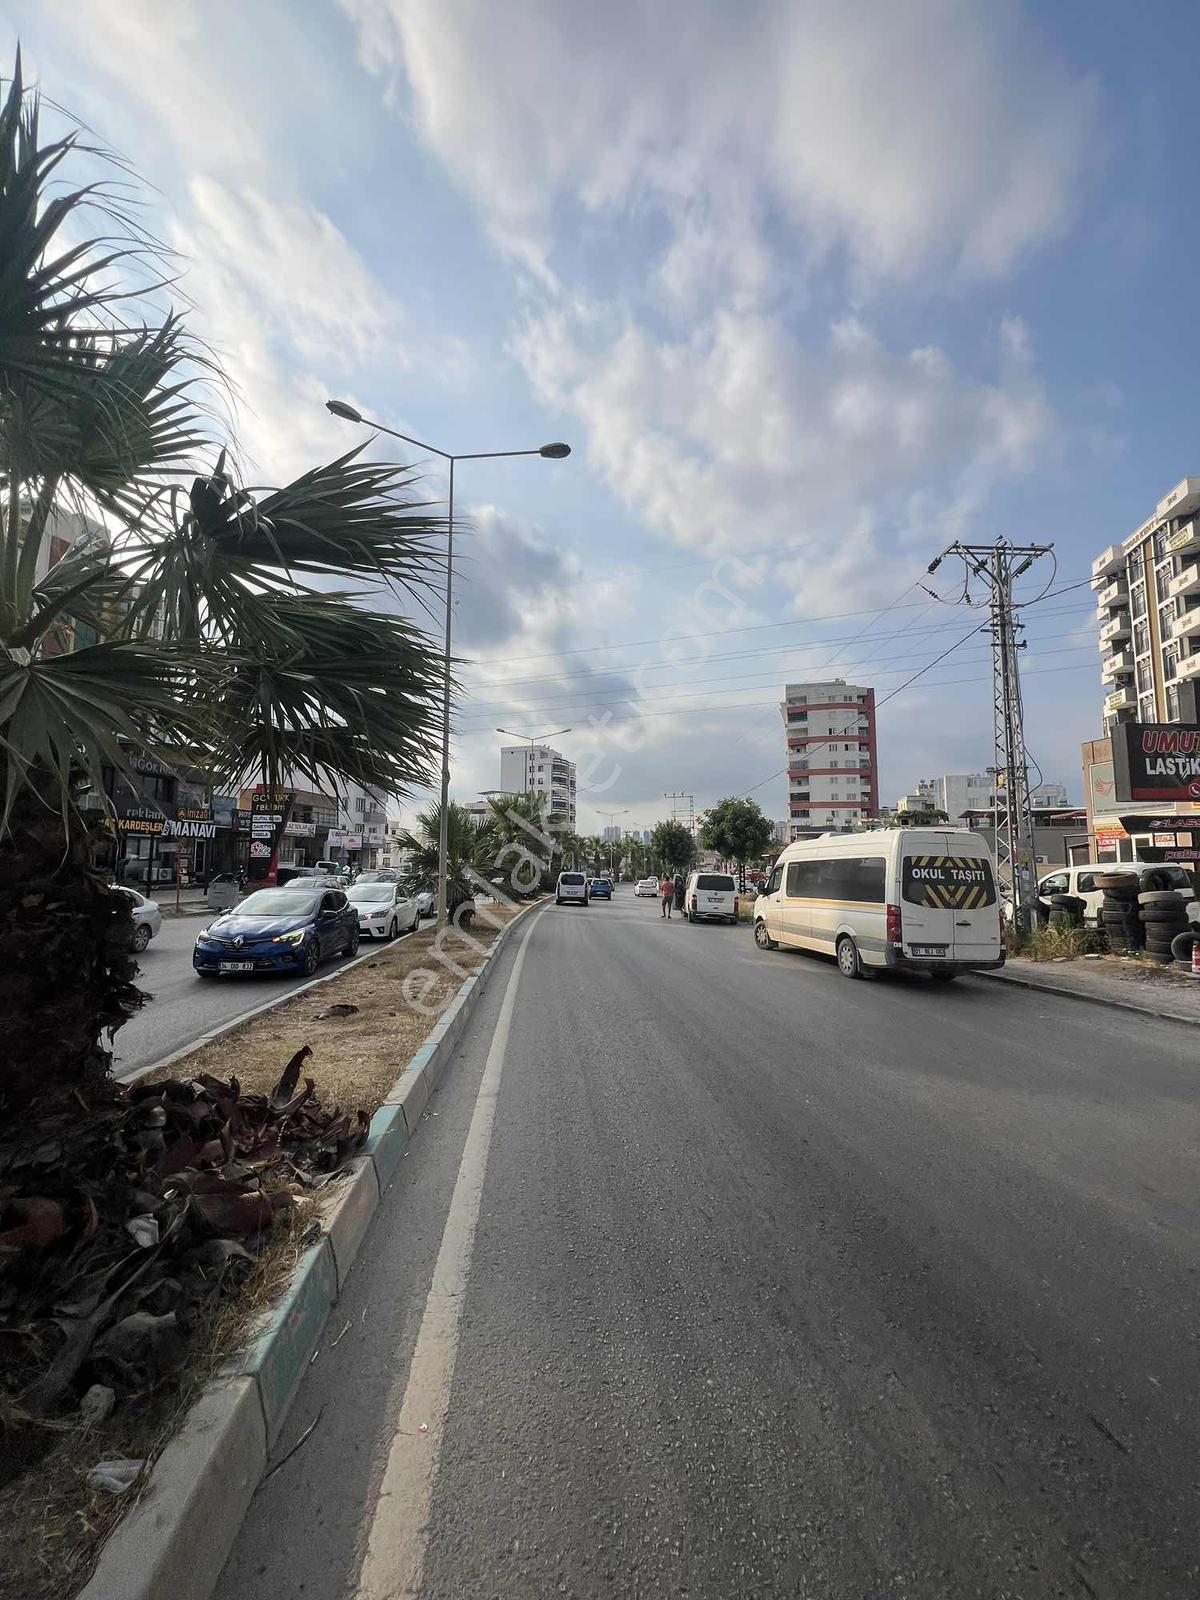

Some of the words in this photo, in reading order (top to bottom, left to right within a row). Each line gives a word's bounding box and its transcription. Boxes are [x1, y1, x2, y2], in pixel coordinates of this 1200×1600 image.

[127, 807, 165, 819] reklam
[118, 819, 163, 834] KARDEŞLER
[171, 820, 216, 838] MANAVI
[912, 868, 945, 880] OKUL
[951, 869, 985, 882] TAŞITI
